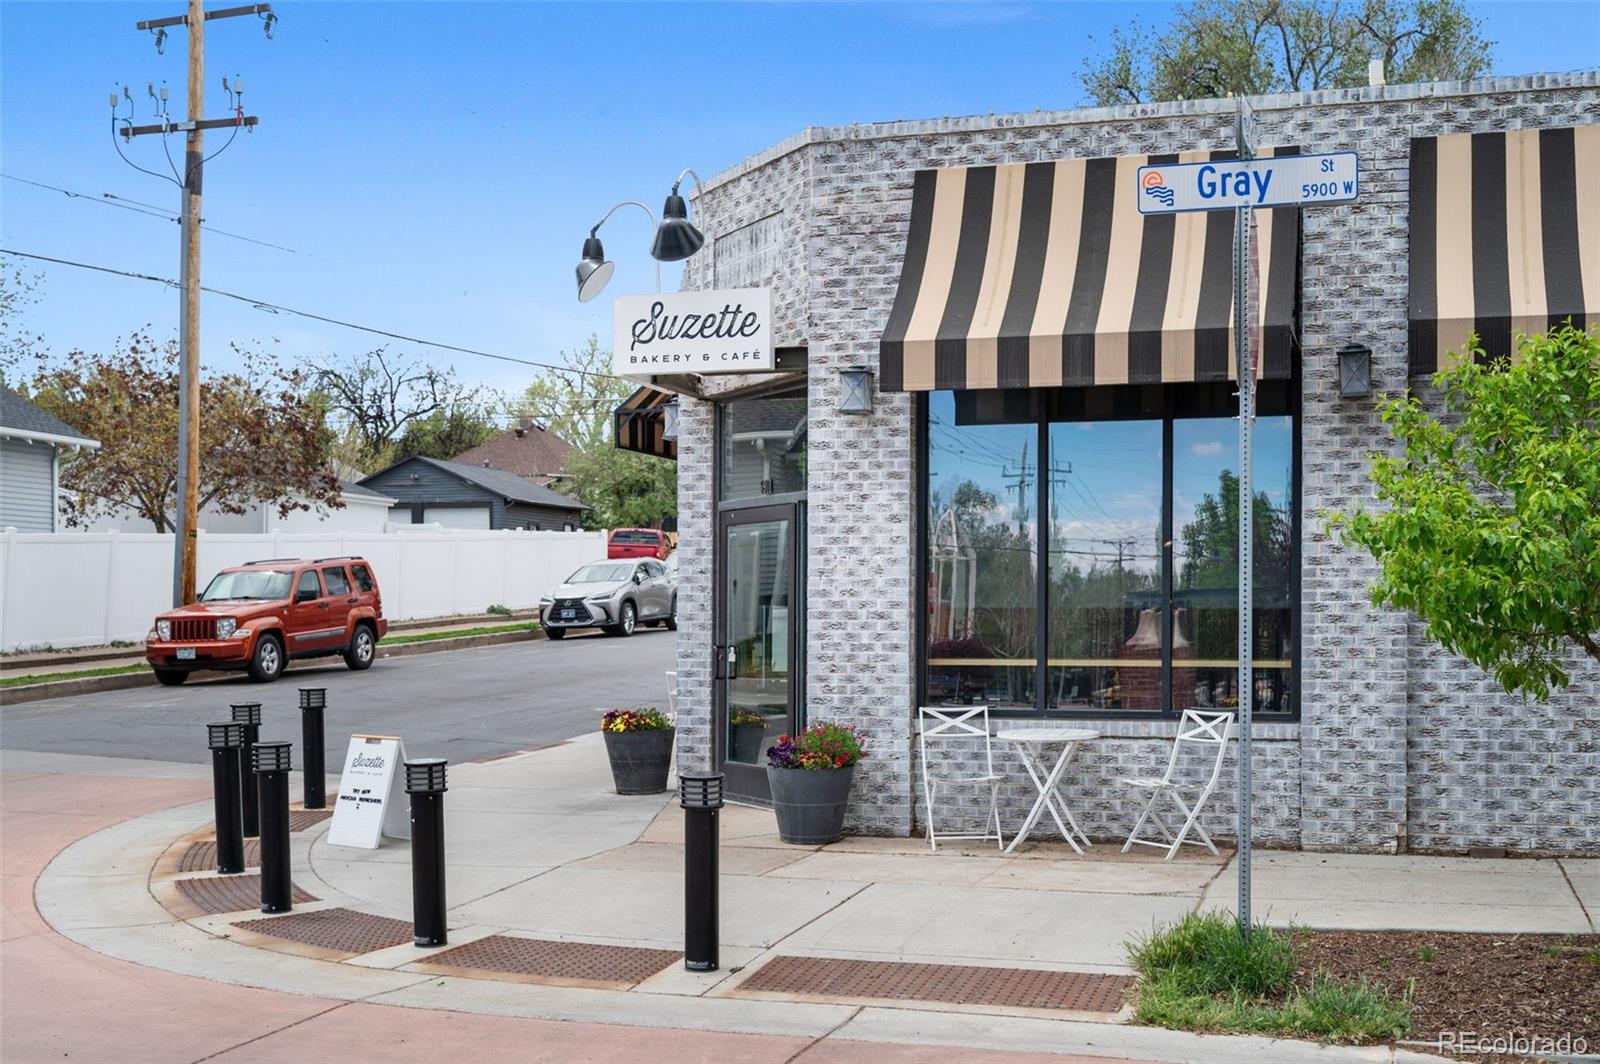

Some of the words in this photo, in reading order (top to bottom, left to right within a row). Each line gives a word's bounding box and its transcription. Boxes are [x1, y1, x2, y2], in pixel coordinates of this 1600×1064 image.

[1320, 159, 1335, 173] St
[1197, 165, 1273, 203] Gray
[1302, 182, 1337, 198] 5900
[1343, 181, 1354, 194] W
[631, 301, 761, 351] Suzette
[630, 354, 692, 364] BAKERY
[703, 353, 710, 361] &
[721, 348, 761, 361] CAFÉ
[351, 752, 385, 769] Suzette
